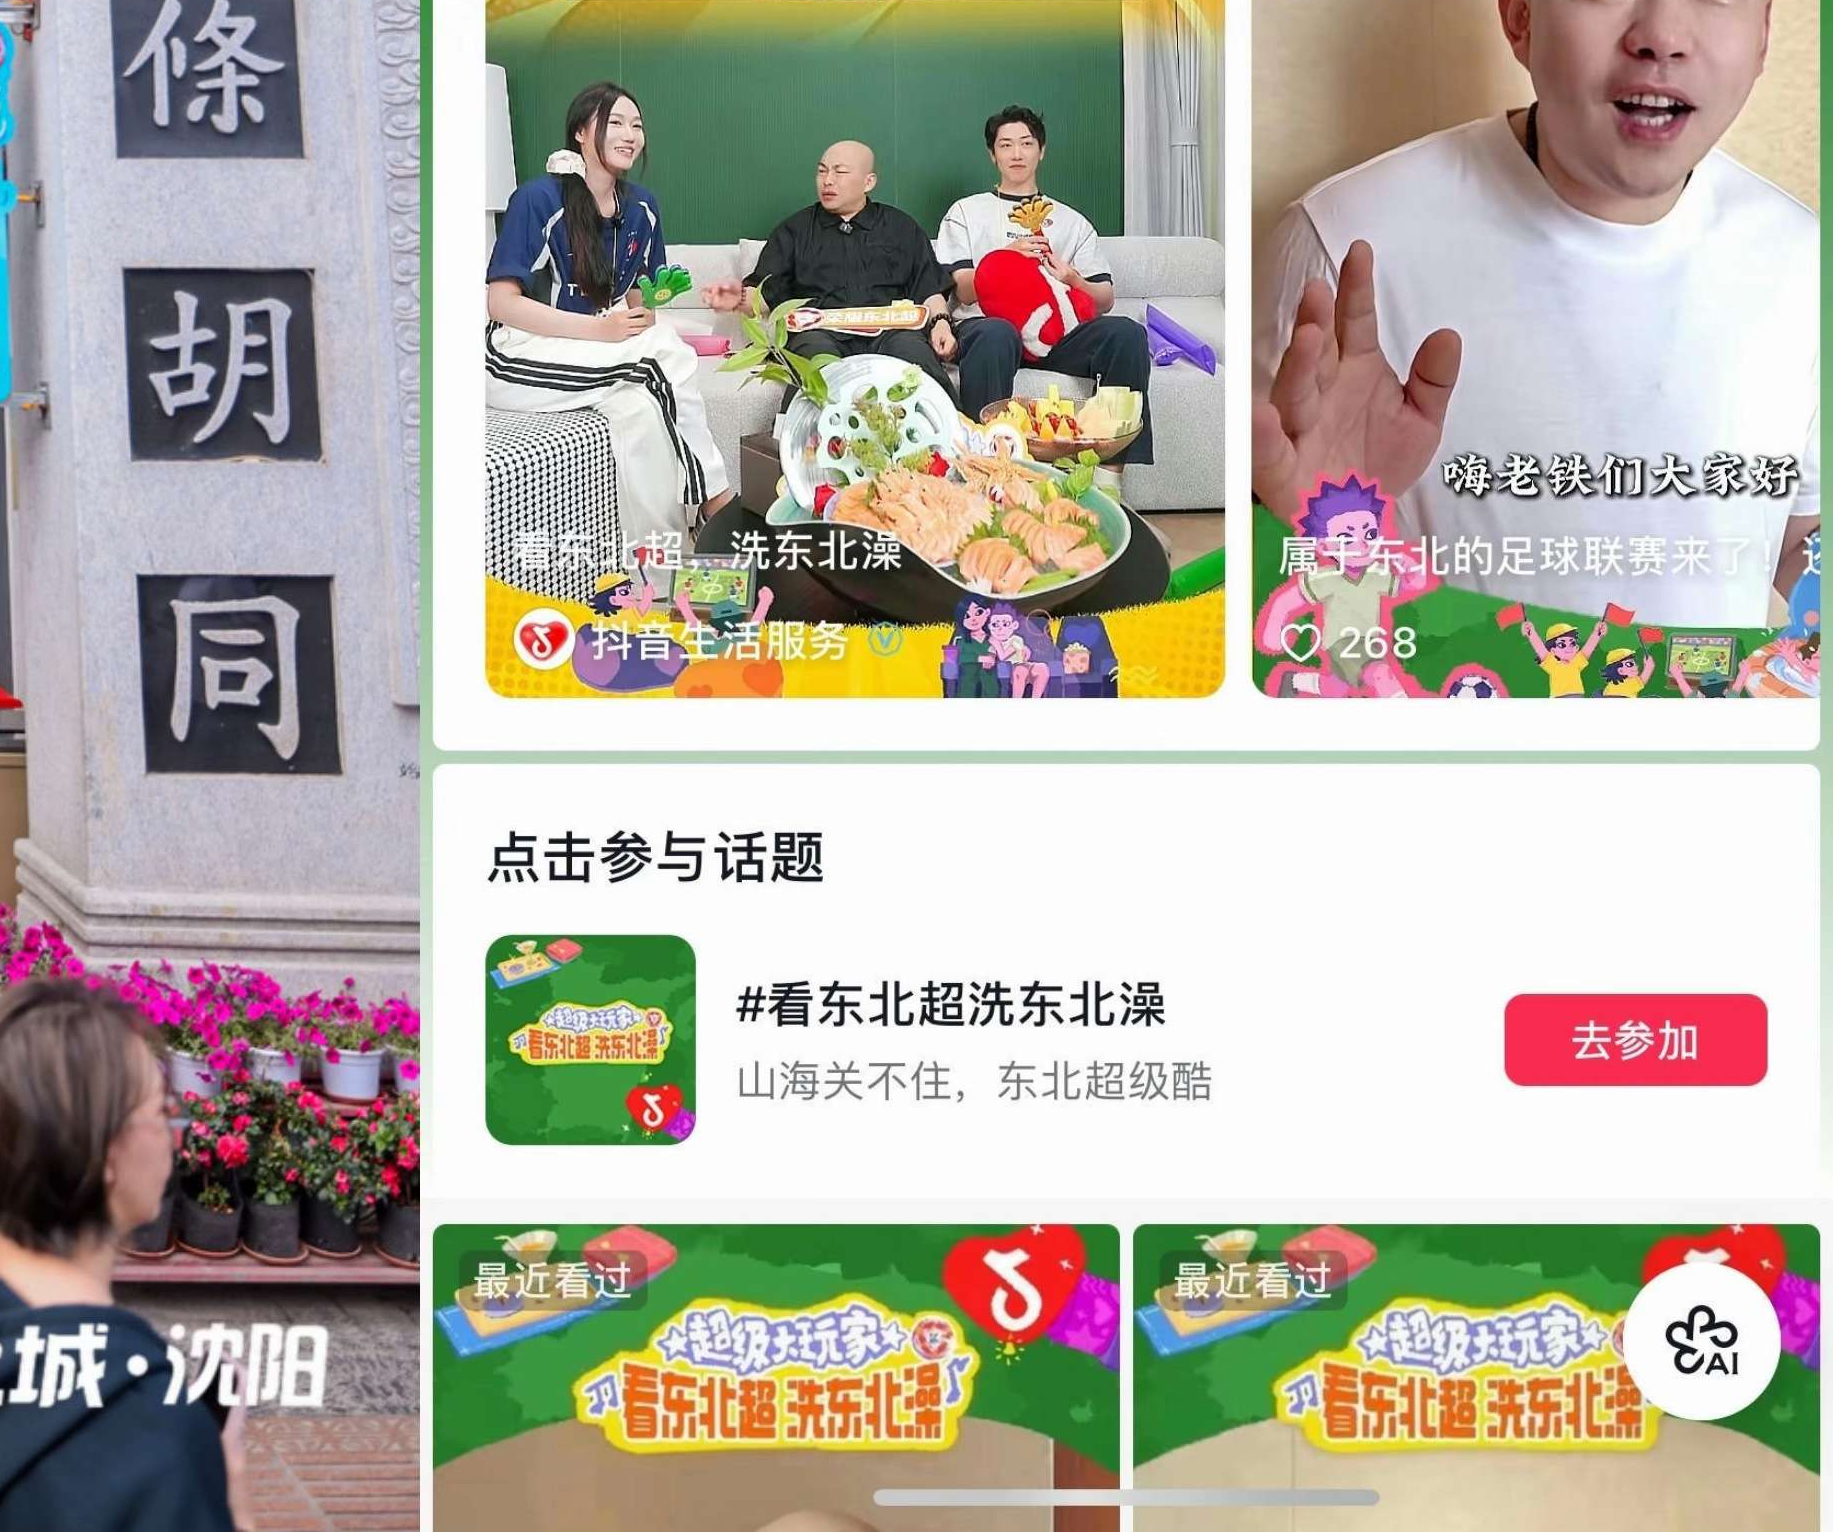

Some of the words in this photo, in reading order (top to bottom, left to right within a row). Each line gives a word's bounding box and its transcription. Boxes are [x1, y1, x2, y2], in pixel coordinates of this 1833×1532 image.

[1441, 451, 1800, 499] 嗨老铁们大家好
[592, 620, 849, 661] 抖音生活服务
[1338, 625, 1418, 659] 268
[486, 829, 825, 884] 点击参与话题
[734, 979, 1167, 1030] #看东北超洗东北澡
[1570, 1018, 1698, 1064] 去参加
[736, 1060, 1212, 1105] 山海关不住，东北超级酷
[473, 1259, 636, 1301] 最近看过
[1173, 1259, 1333, 1301] 最近看过
[681, 1306, 889, 1378] 超级大玩家
[1381, 1306, 1591, 1378] 超级大玩家
[1704, 1351, 1741, 1377] AI
[622, 1359, 778, 1442] 看东北超
[784, 1359, 944, 1442] 洗东北澡
[1322, 1359, 1477, 1442] 看东北超
